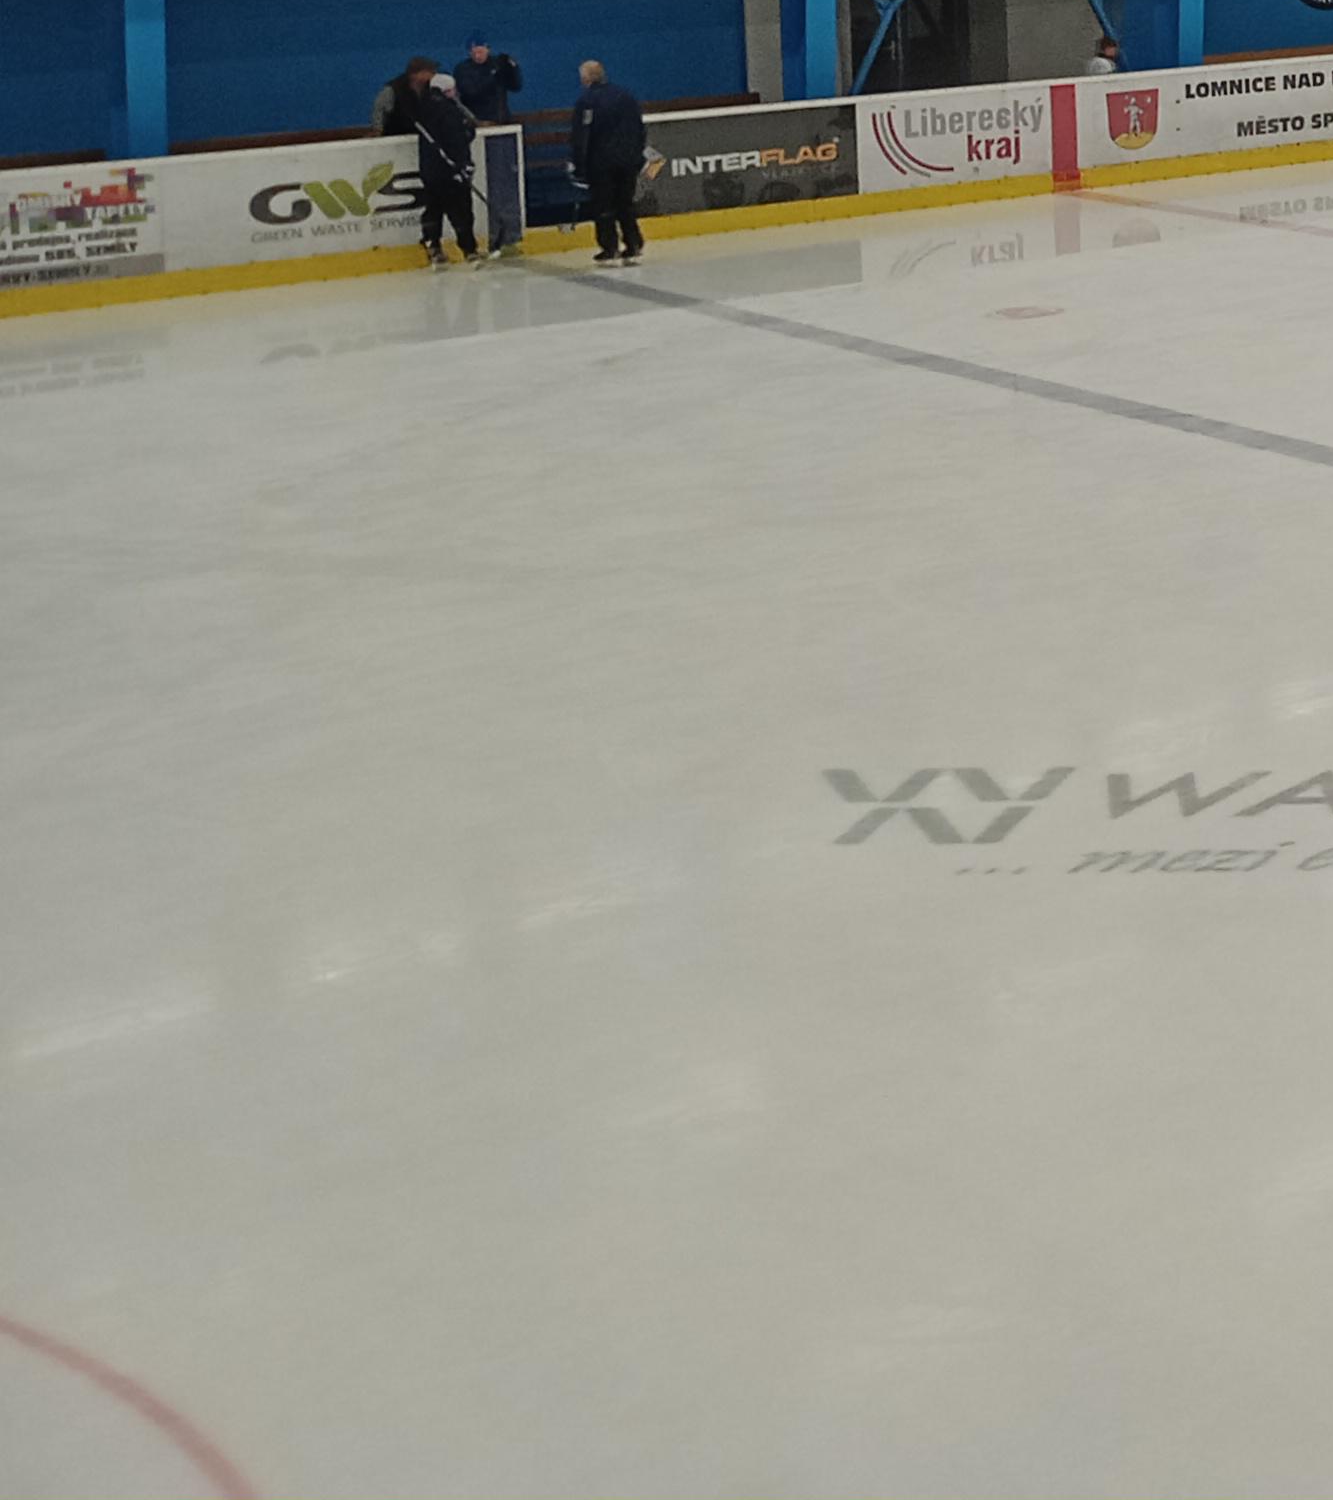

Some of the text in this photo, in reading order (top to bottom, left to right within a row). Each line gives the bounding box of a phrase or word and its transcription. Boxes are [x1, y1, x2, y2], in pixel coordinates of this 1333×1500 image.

[1185, 76, 1276, 99] LOMNICE
[1283, 72, 1325, 91] NAD
[1237, 115, 1305, 137] MĚSTO
[671, 143, 838, 177] INTERFLAG
[967, 129, 1021, 165] kraj
[311, 221, 362, 237] WASTE
[1066, 840, 1296, 875] mezi
